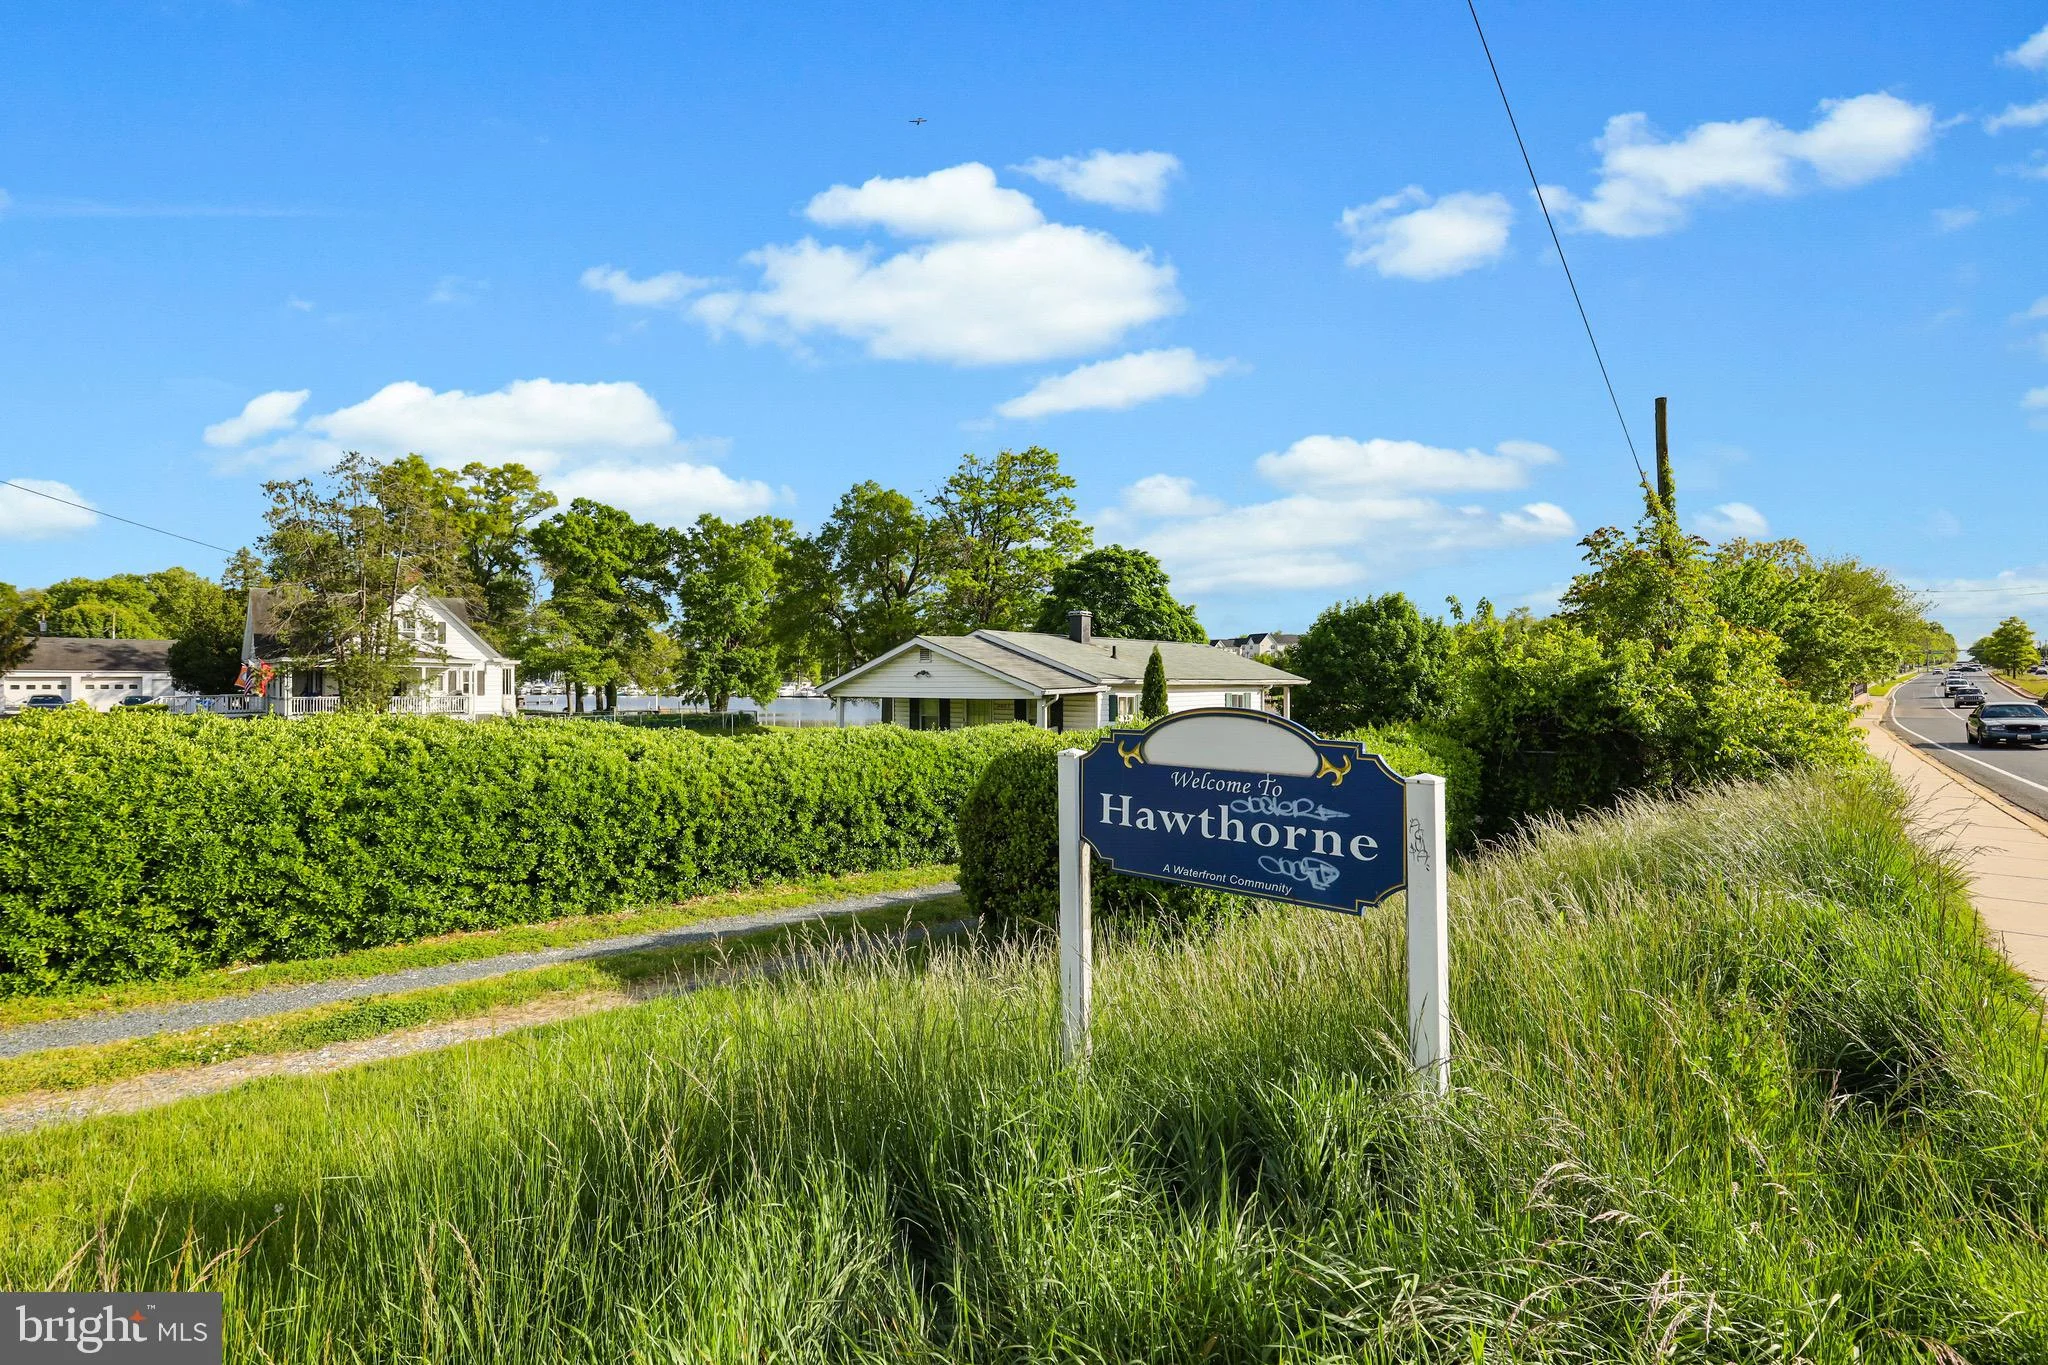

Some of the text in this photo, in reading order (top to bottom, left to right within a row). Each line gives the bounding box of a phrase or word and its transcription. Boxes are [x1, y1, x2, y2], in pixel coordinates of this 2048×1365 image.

[1170, 770, 1283, 797] Welcome To
[1099, 792, 1379, 862] Hawthorne
[1162, 863, 1293, 896] A Waterfront Community
